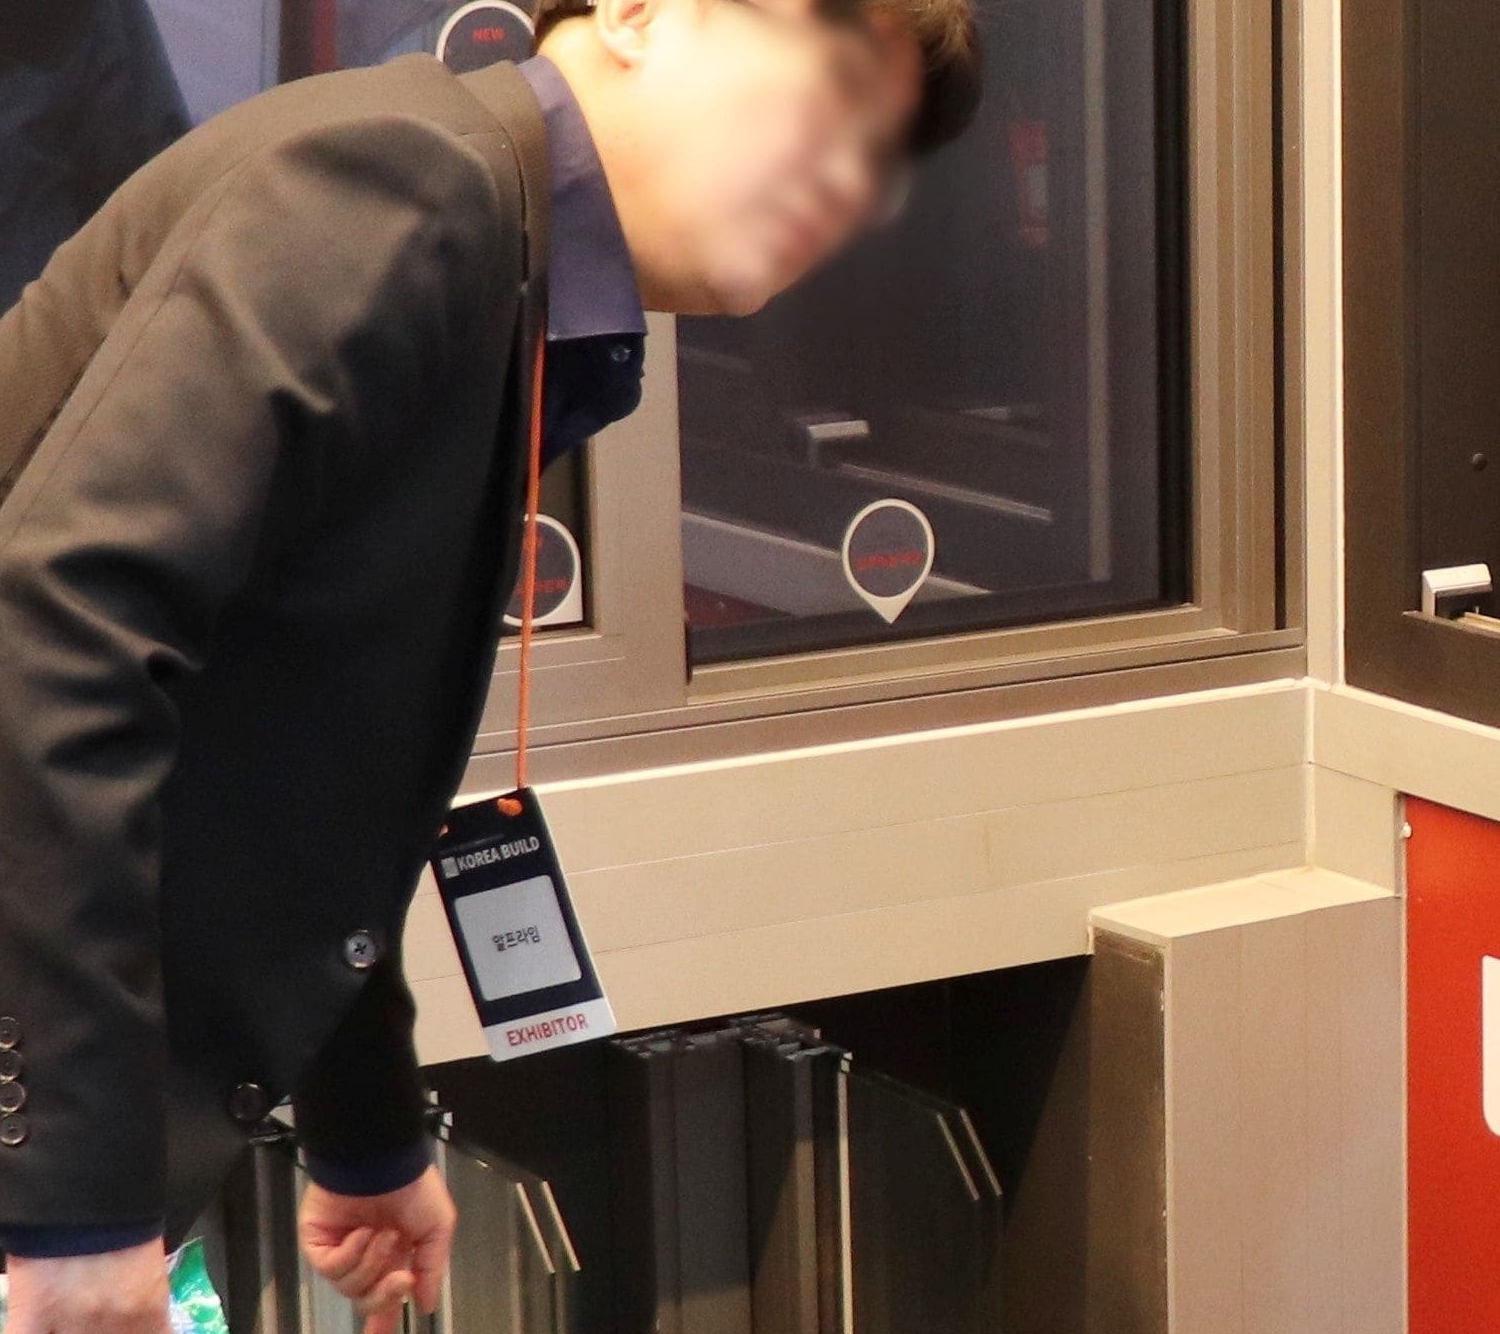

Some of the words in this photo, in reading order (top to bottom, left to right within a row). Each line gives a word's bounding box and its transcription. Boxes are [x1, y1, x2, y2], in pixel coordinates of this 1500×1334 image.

[459, 846, 501, 871] KOREA
[502, 836, 540, 859] BUILD
[506, 1014, 589, 1046] EXHIBITOR
